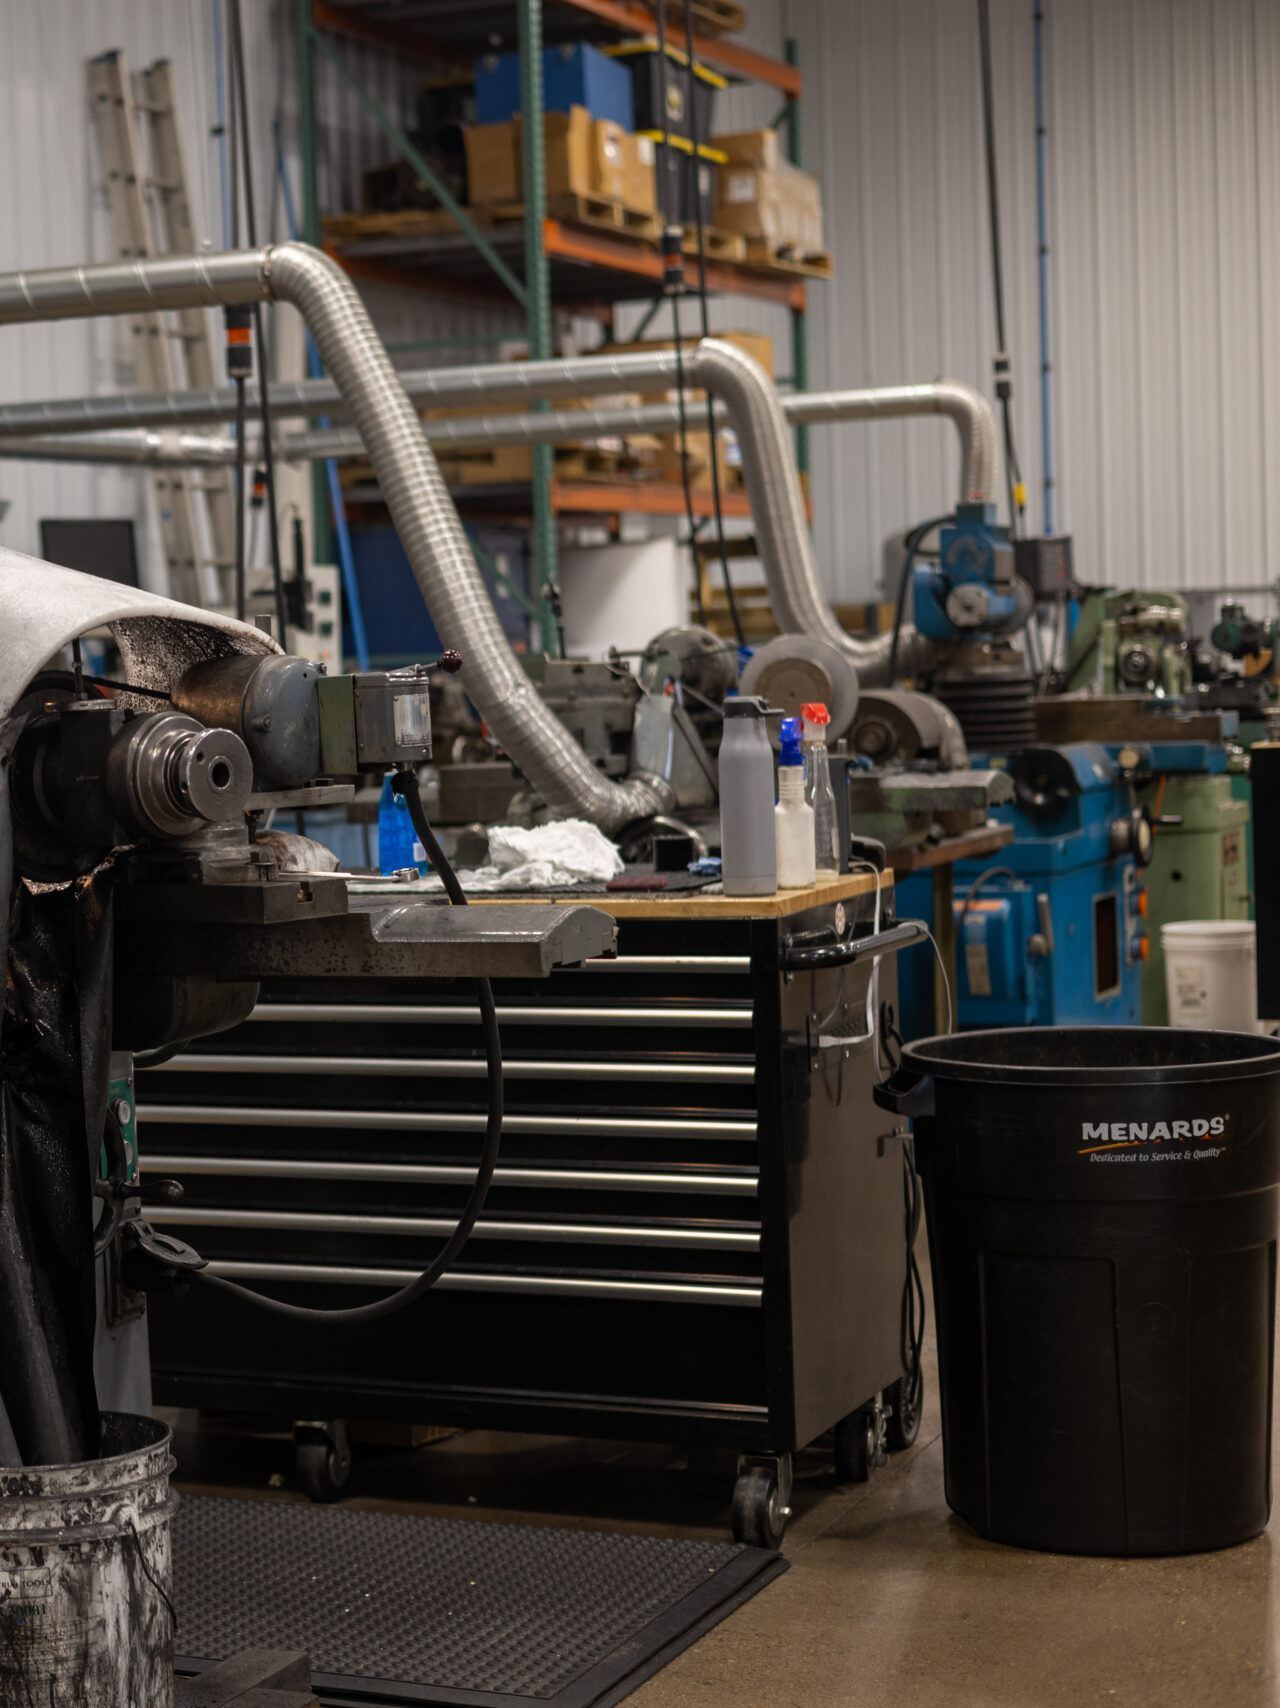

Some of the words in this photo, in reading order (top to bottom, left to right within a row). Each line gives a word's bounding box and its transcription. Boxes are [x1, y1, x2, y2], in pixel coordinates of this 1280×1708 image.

[1082, 1116, 1225, 1140] MENARDS
[1090, 1152, 1137, 1162] Dedicated
[1139, 1152, 1149, 1162] to
[1151, 1151, 1182, 1161] Service
[1184, 1150, 1192, 1160] &
[1193, 1147, 1221, 1160] Quality
[22, 1580, 52, 1588] TOOLS
